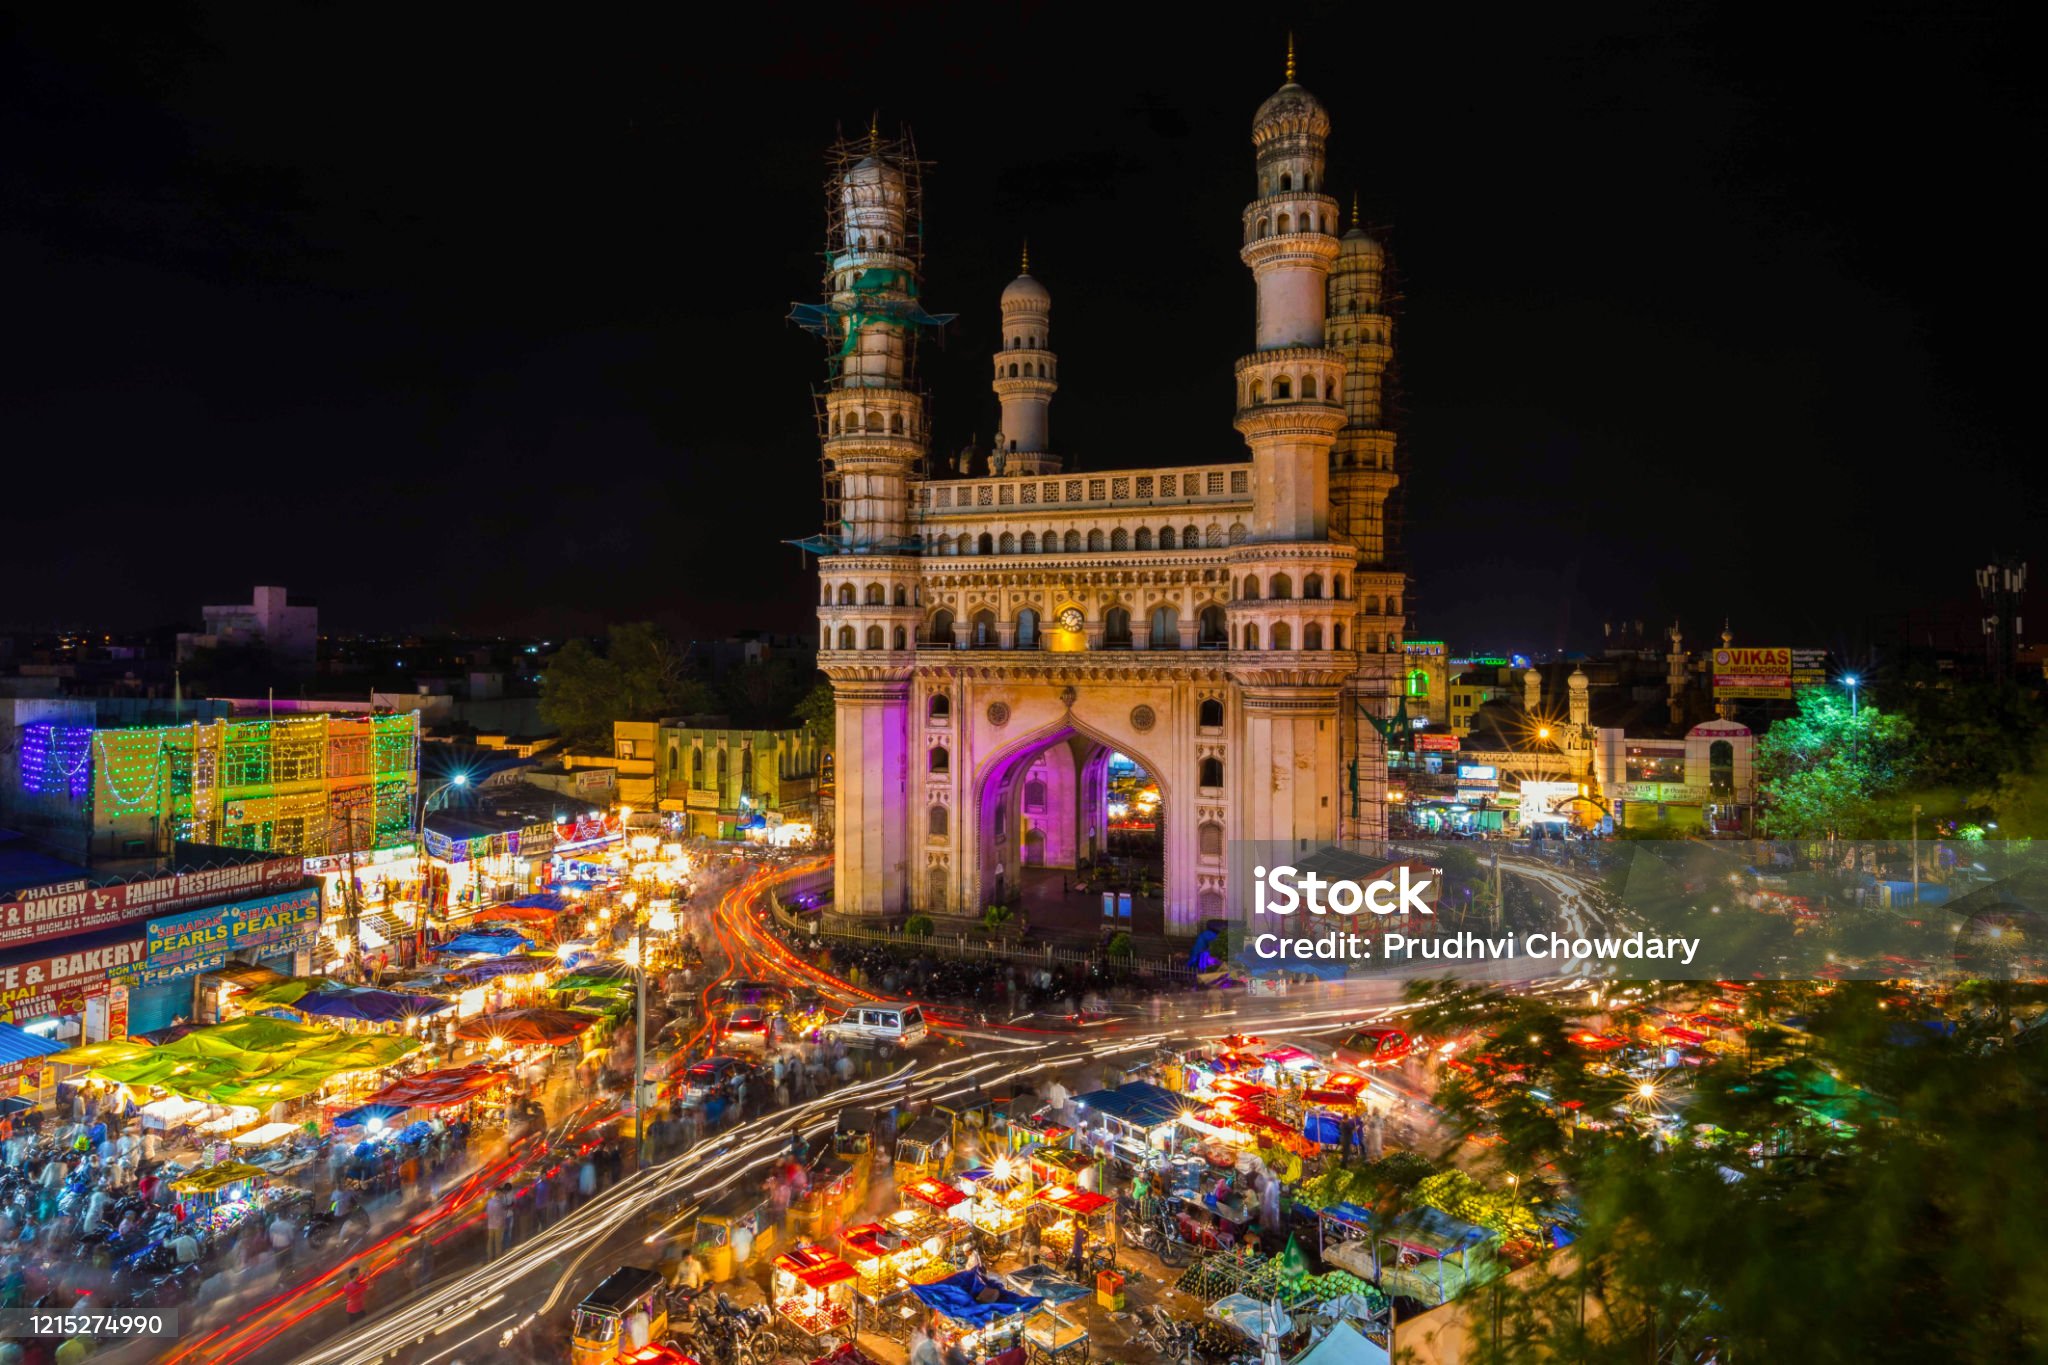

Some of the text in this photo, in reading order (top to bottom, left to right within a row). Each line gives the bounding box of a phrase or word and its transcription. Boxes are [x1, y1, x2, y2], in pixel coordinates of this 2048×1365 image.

[1730, 650, 1789, 665] VIKAS
[1730, 666, 1789, 674] HIGH SCHOOL
[28, 880, 86, 900] HALEEM
[125, 876, 176, 905] FAMILY
[178, 863, 265, 895] RESTAURANT
[7, 893, 88, 926] & BAKERY
[238, 900, 310, 922] SHAADAN
[36, 920, 73, 935] MUGHLAI
[157, 917, 223, 939] SHAADAN
[232, 906, 318, 937] PEARLS
[150, 925, 229, 955] PEARLS
[261, 934, 315, 956] PEARLS
[25, 966, 45, 985] &
[51, 940, 145, 980] BAKERY
[143, 956, 222, 983] PEARLS
[0, 985, 36, 1002] HAI
[14, 998, 57, 1020] HALEEM
